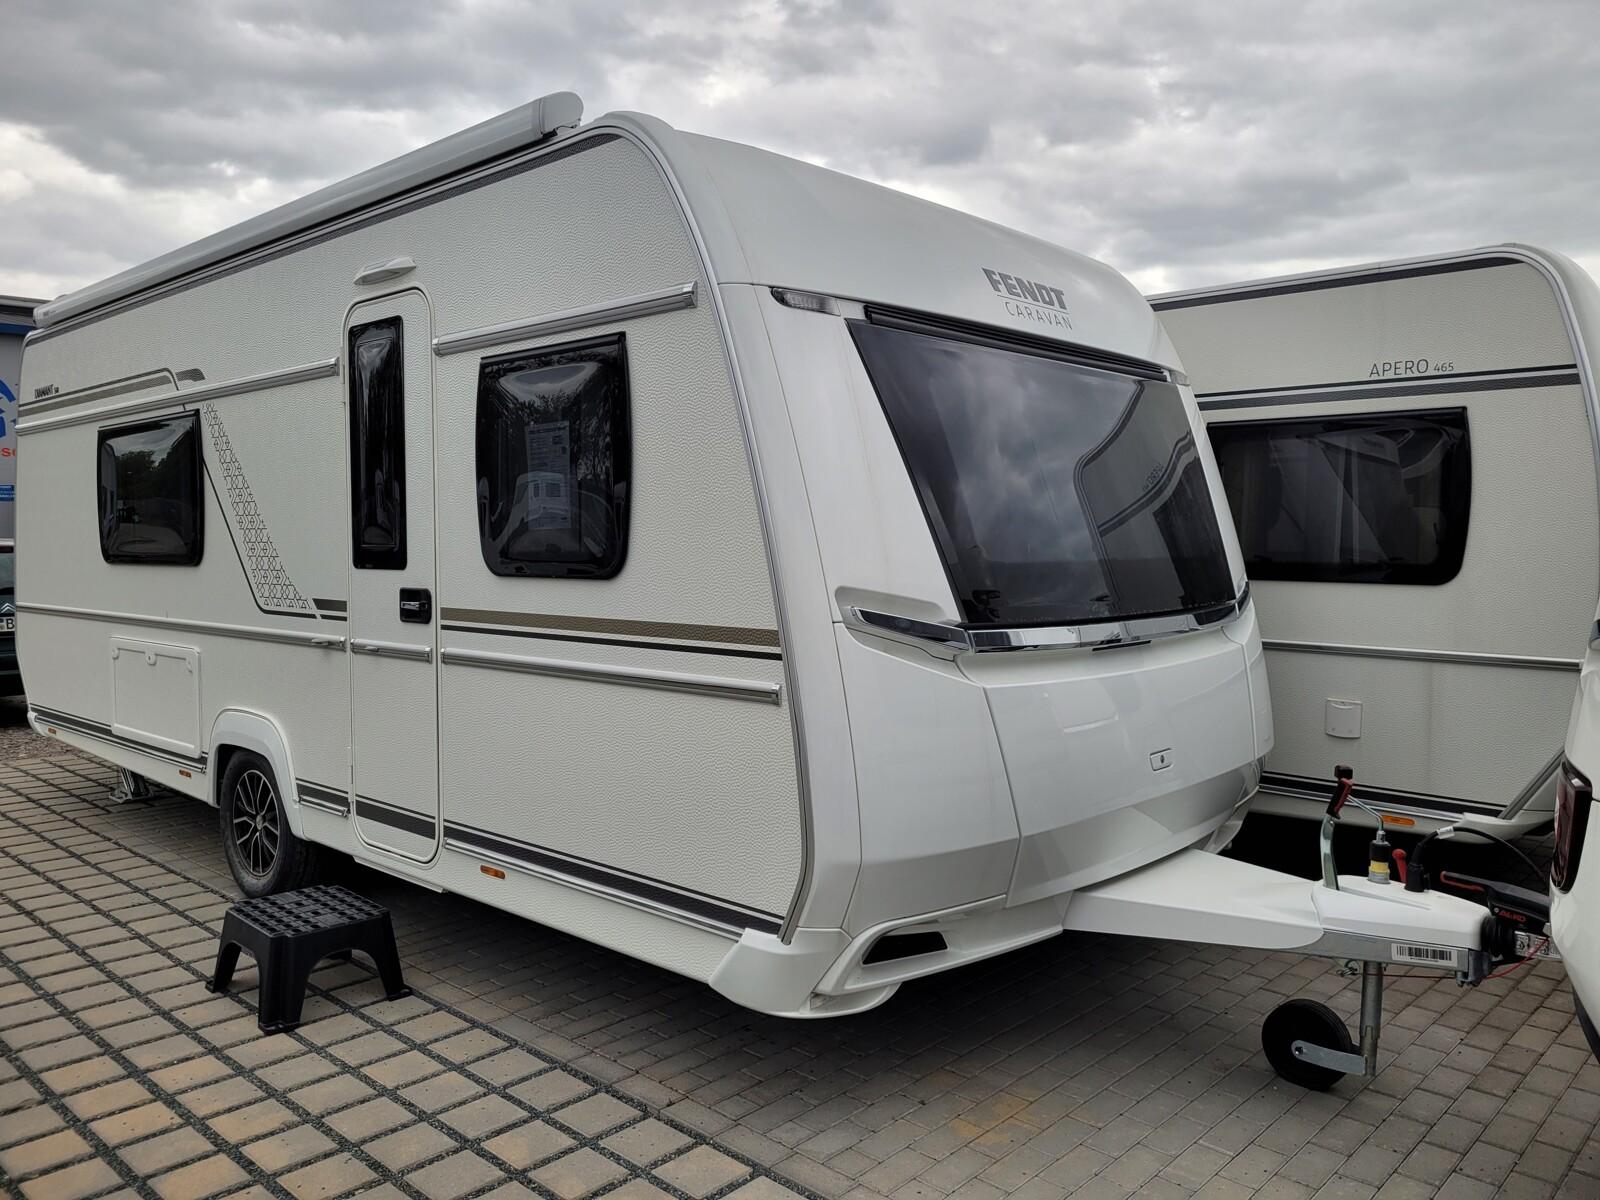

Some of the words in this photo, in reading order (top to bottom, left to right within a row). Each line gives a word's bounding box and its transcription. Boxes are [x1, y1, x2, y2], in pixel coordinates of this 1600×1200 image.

[981, 267, 1067, 310] FENDT
[1005, 301, 1072, 330] CARAVAN
[1369, 358, 1429, 377] APERO
[1433, 361, 1454, 373] 465
